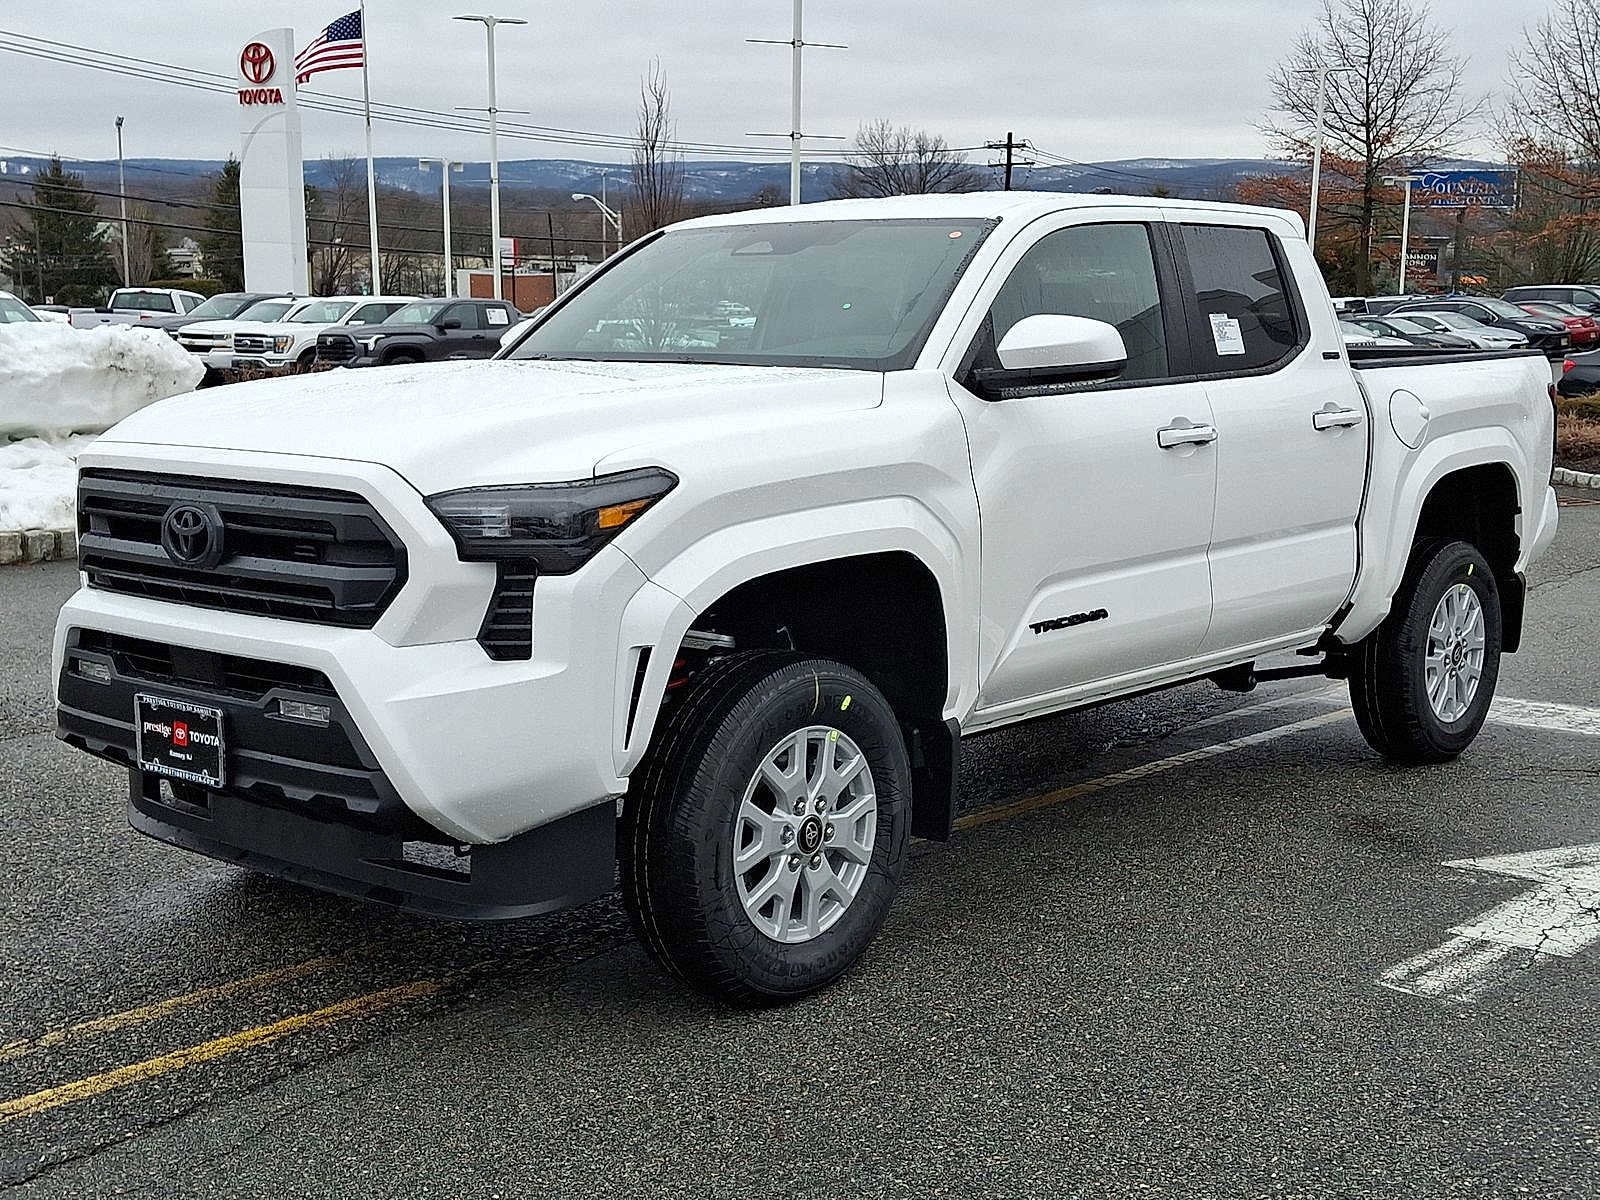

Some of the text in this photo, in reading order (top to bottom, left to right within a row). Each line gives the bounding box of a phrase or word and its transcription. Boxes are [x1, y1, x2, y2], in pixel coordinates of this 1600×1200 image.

[238, 88, 284, 105] TOYOTA
[1028, 608, 1109, 634] TACOMA
[144, 722, 219, 746] prestige TOYOTA
